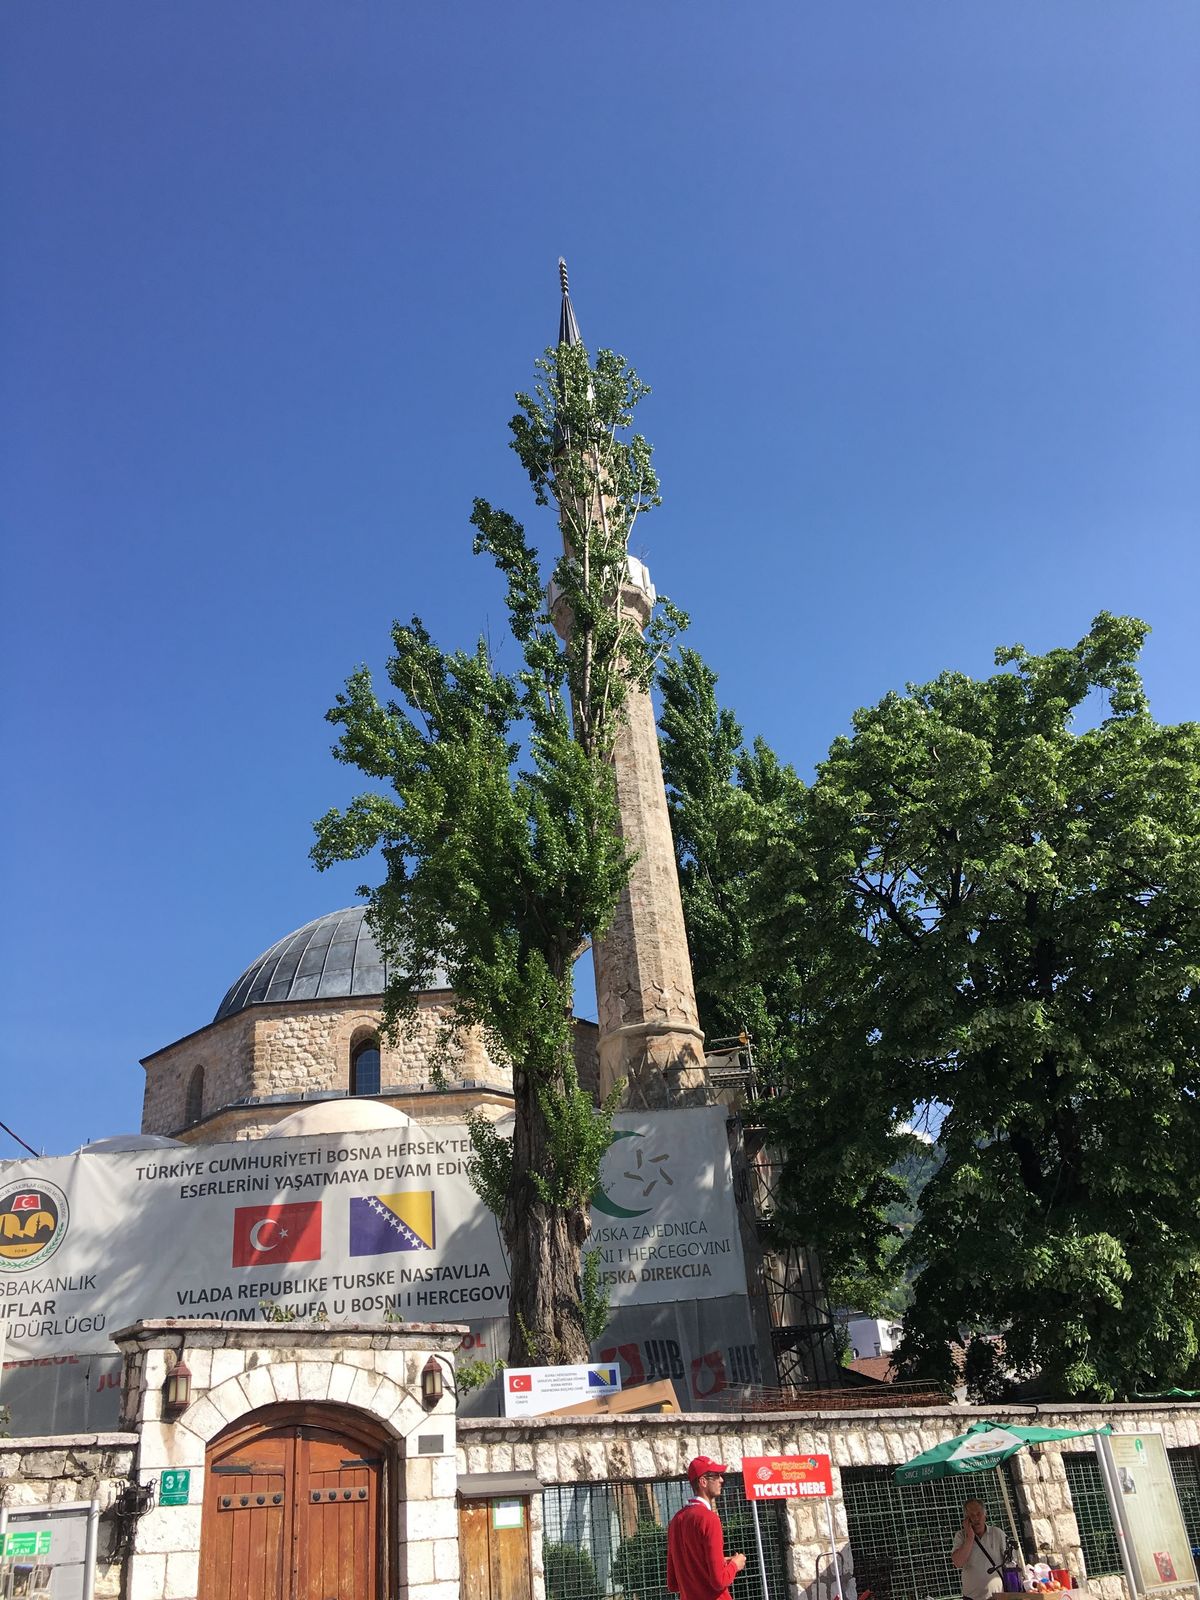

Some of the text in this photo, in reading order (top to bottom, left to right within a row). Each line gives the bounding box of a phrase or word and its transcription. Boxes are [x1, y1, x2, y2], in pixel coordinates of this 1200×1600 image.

[136, 1161, 204, 1180] TÜRKİYE
[209, 1148, 321, 1173] CUMHURİYETİ
[327, 1146, 382, 1163] BOSNA
[180, 1174, 269, 1199] ESERLERİNİ
[274, 1169, 369, 1191] YAŞATMAYA
[374, 1163, 432, 1180] DEVAM
[632, 1221, 708, 1239] ZAJEDNICA
[618, 1248, 624, 1262] I
[628, 1239, 731, 1261] HERCEGOVINI
[177, 1263, 490, 1305] VLADA REPUBLIKE TURSKE NASTAVLJA
[641, 1264, 712, 1282] DIREKCIJA
[334, 1300, 345, 1314] U
[352, 1293, 401, 1312] BOSNI
[407, 1292, 411, 1306] I
[165, 1472, 186, 1489] 37
[752, 1481, 827, 1497] TICKETS HERE
